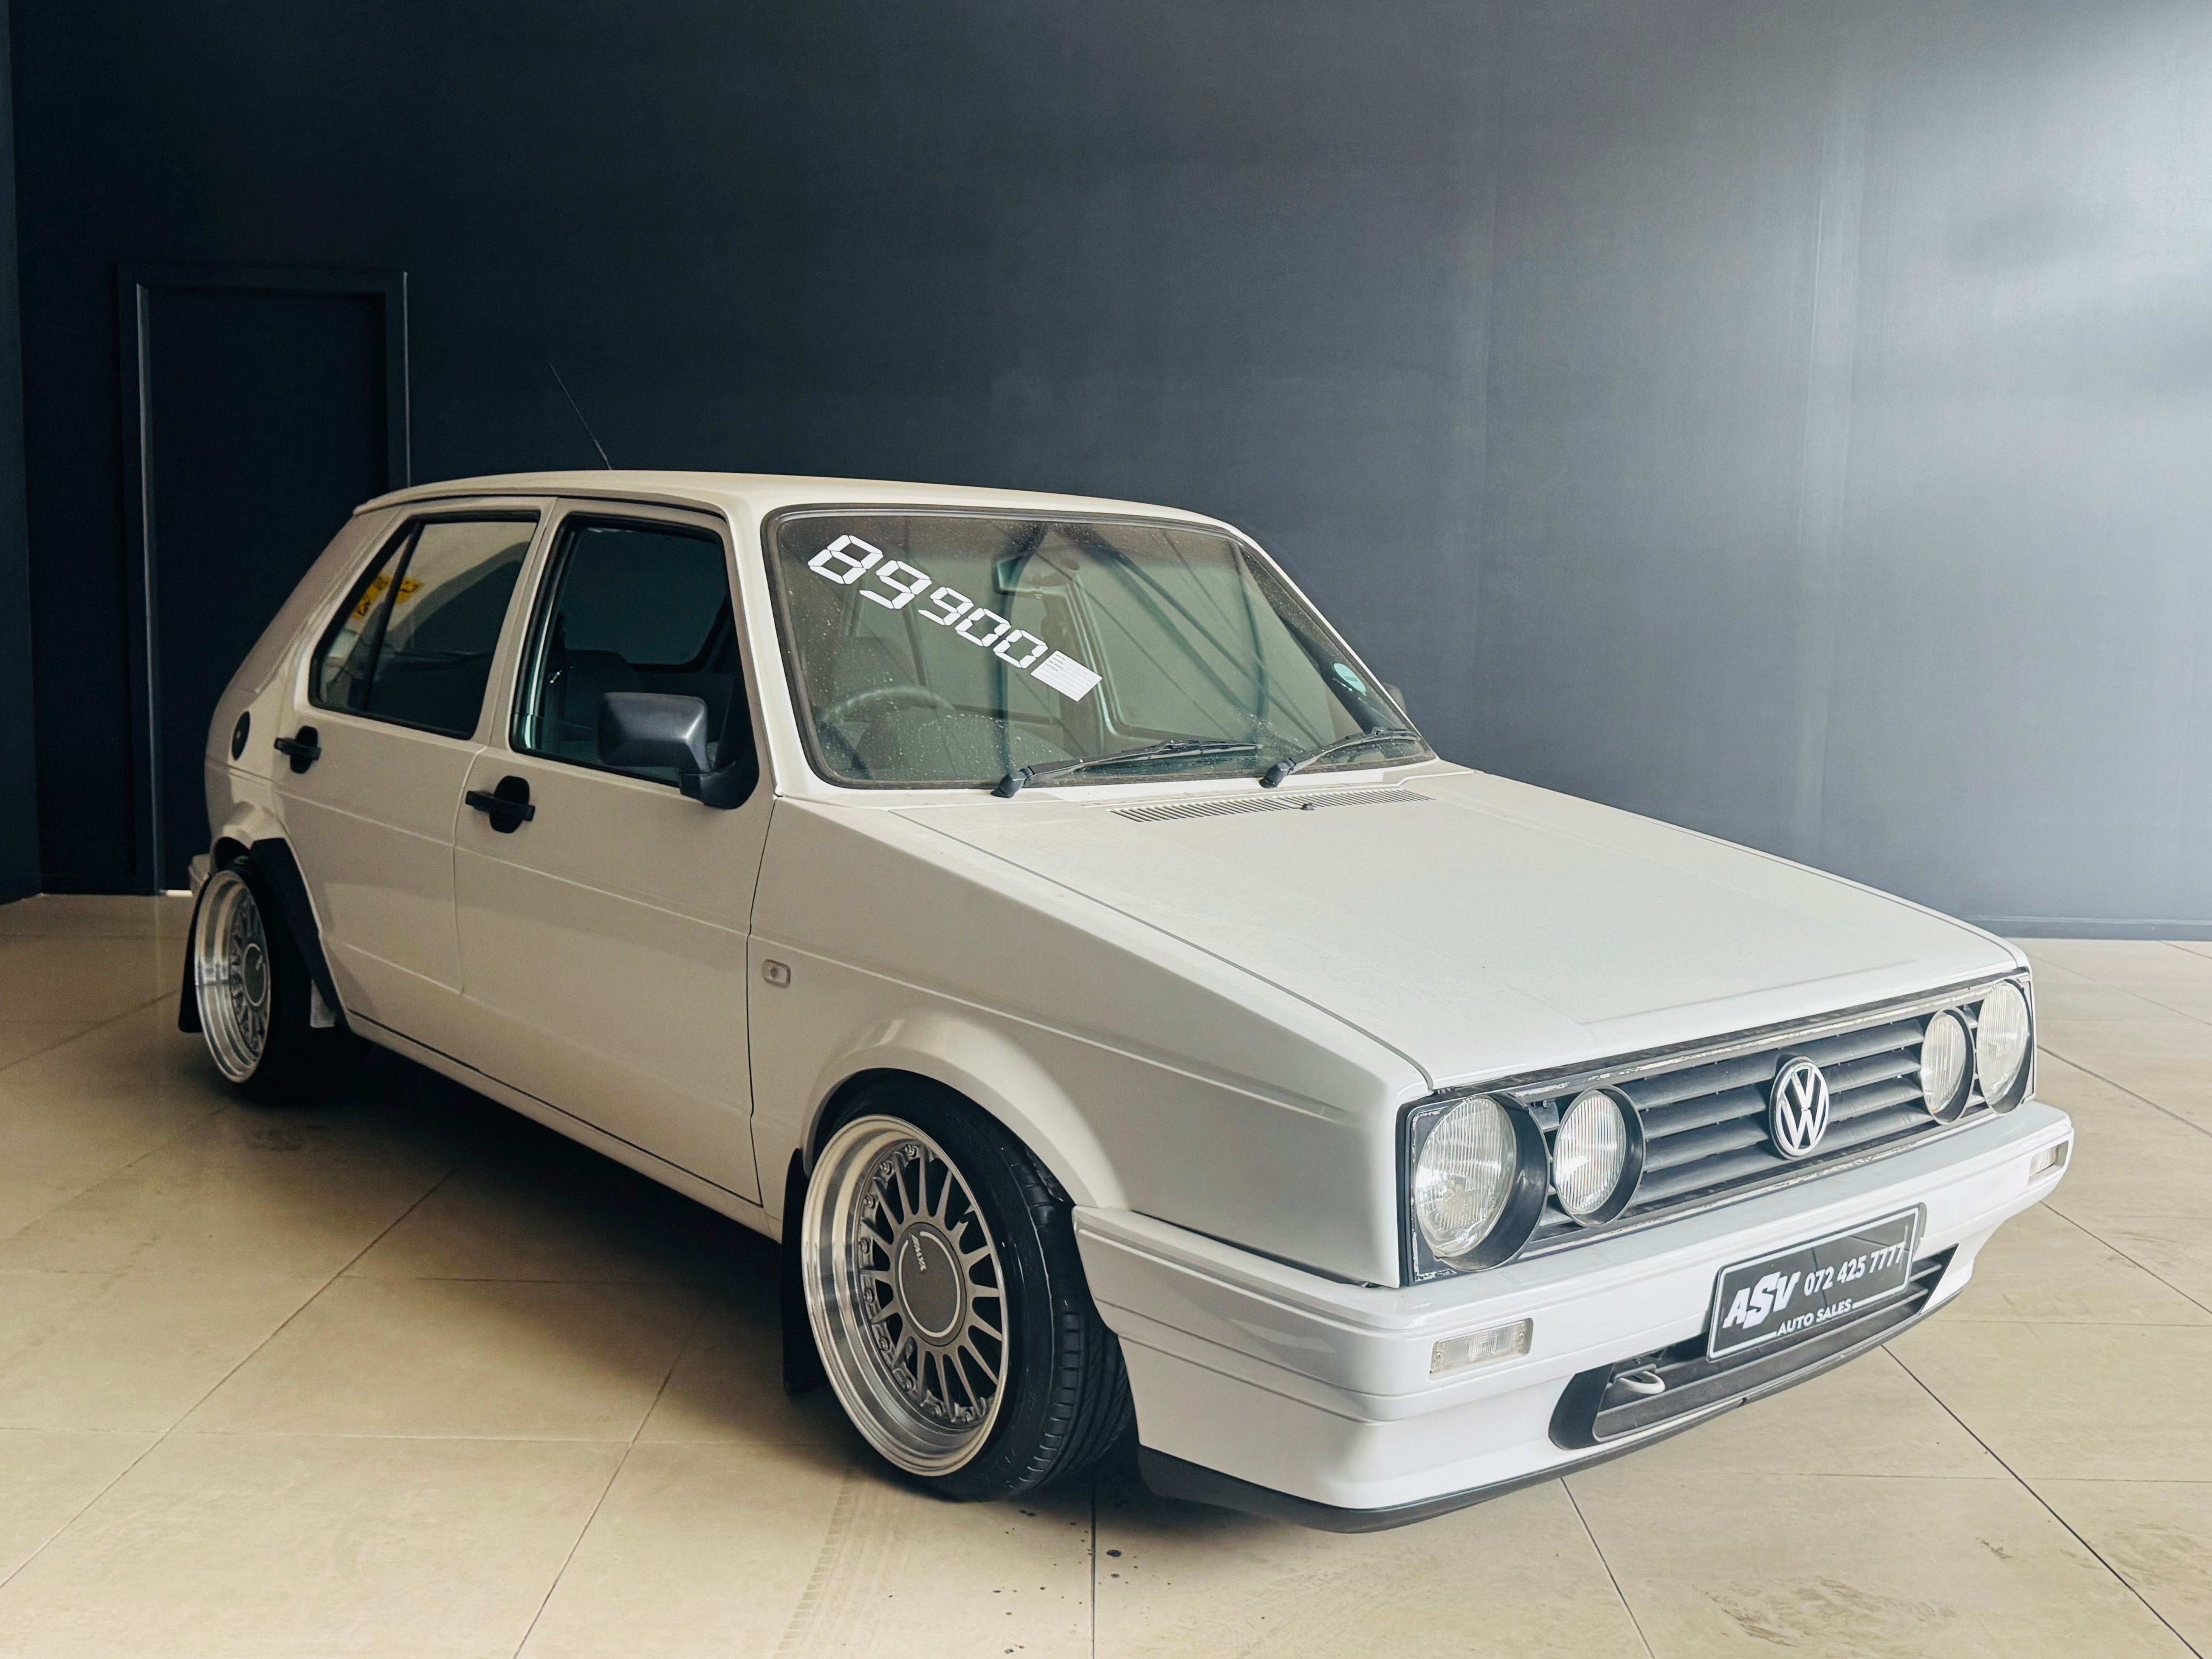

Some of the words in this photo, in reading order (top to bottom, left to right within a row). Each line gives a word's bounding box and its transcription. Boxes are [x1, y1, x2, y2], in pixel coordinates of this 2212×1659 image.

[1776, 1062, 1829, 1156] VW
[1722, 1271, 1801, 1329] ASV
[1804, 1266, 1834, 1296] 072
[1837, 1255, 1867, 1283] 425
[1869, 1241, 1906, 1273] 7777
[1776, 1312, 1814, 1336] AUTO
[1816, 1298, 1852, 1323] SALES
